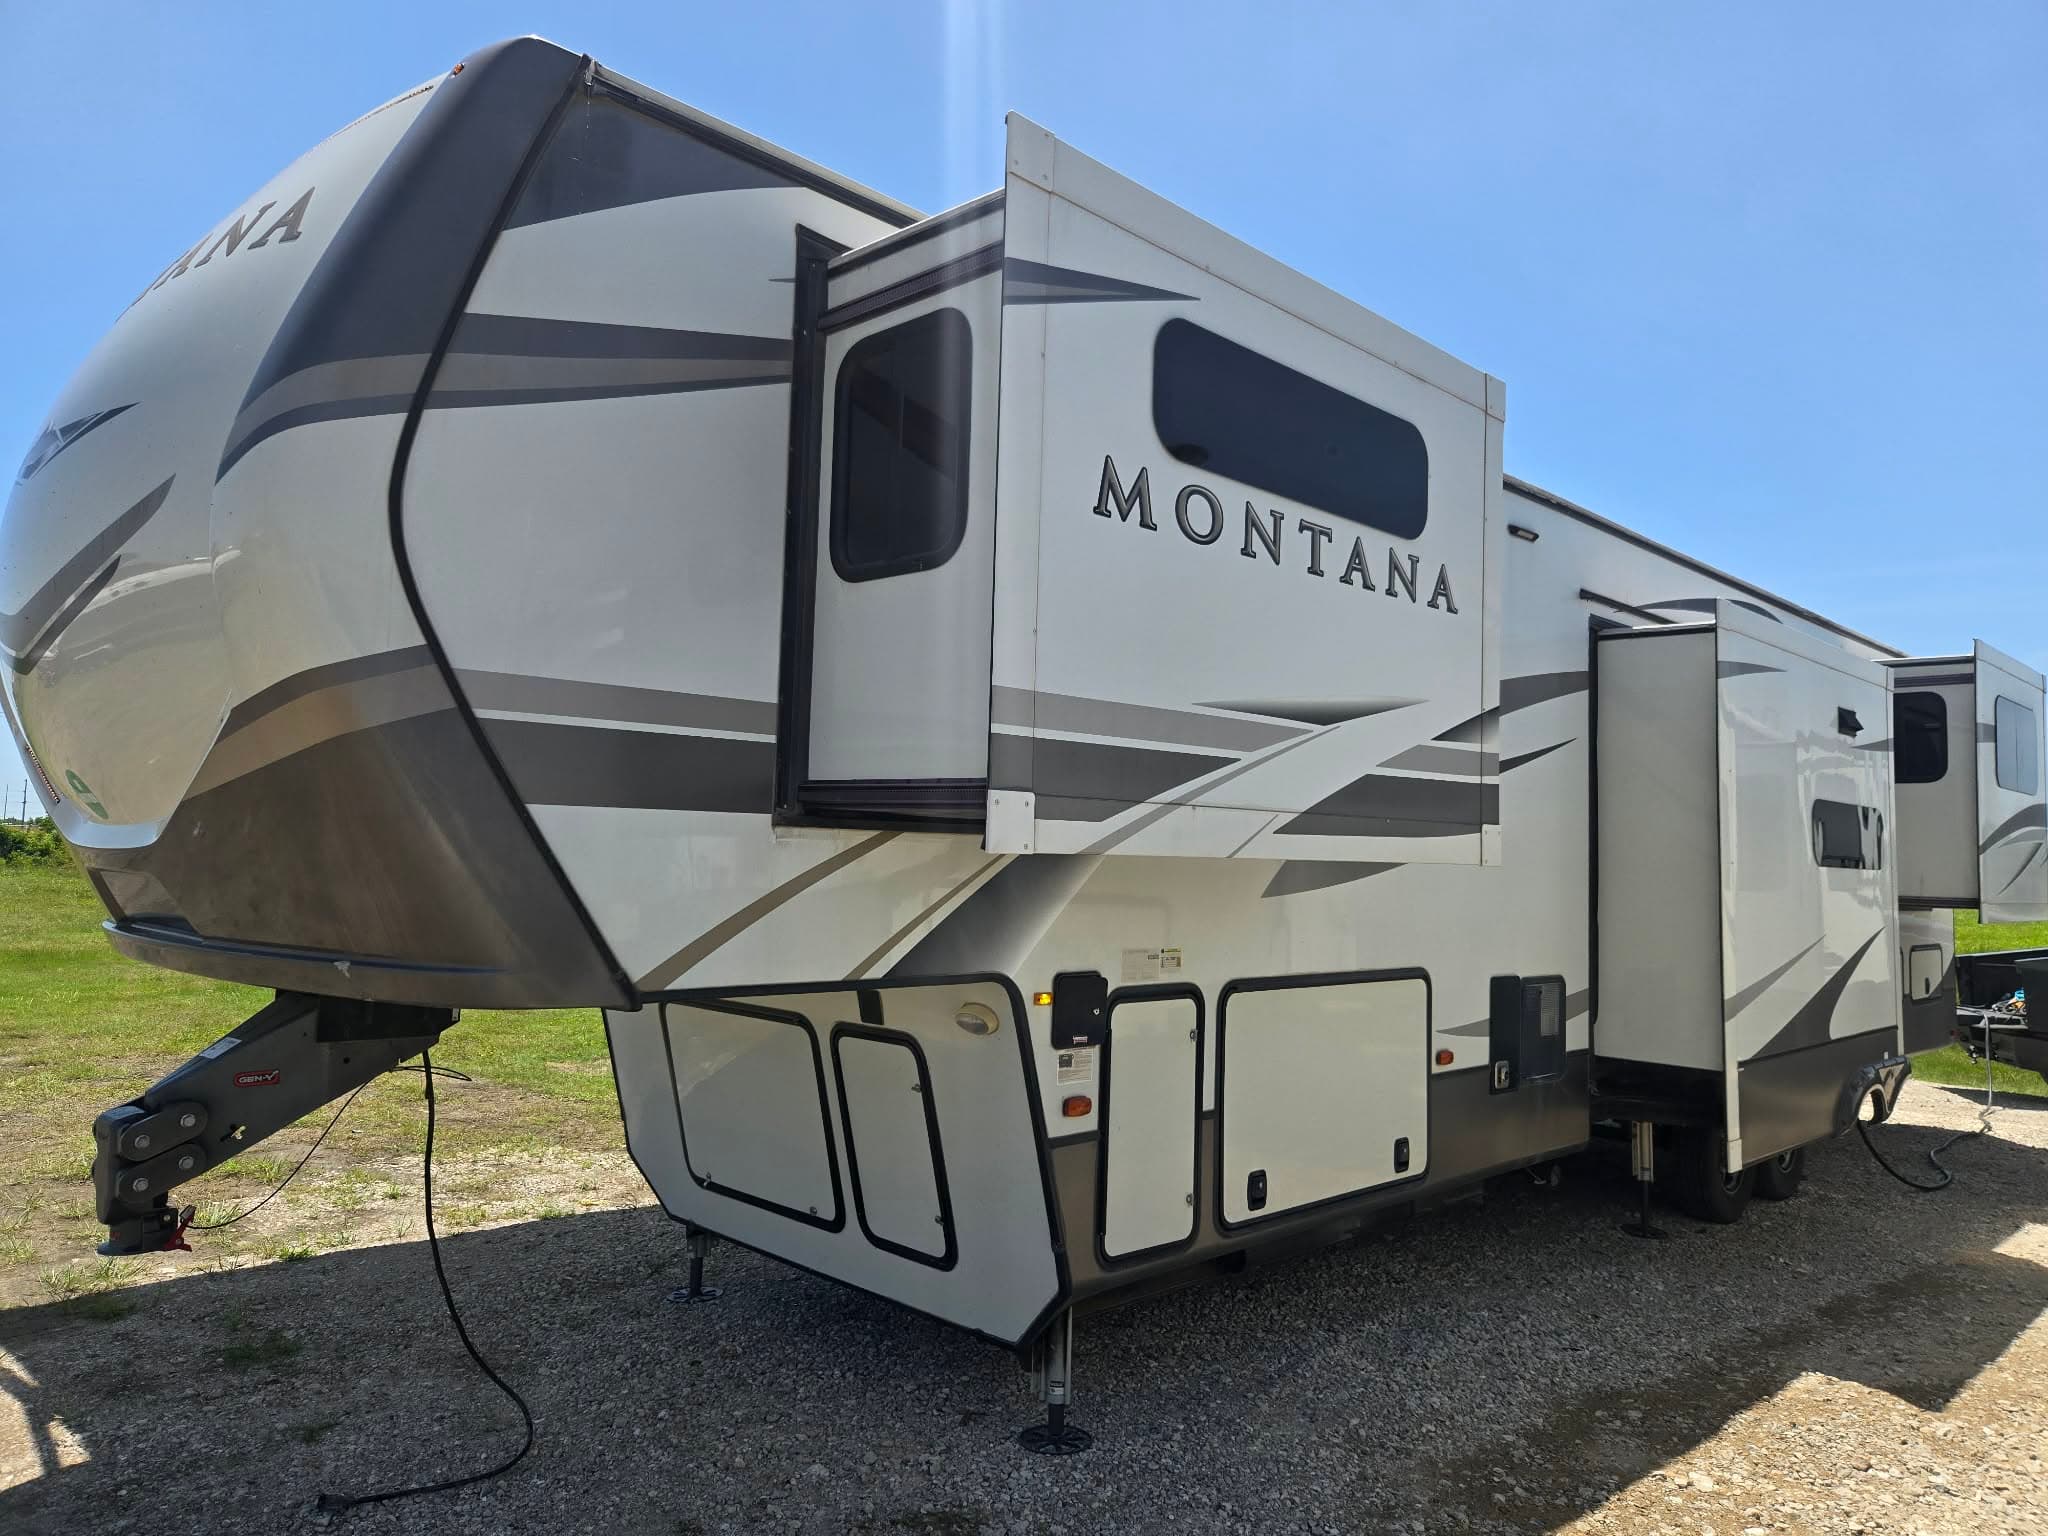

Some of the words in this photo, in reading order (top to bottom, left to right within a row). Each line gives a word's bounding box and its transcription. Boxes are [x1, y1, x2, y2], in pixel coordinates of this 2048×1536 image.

[128, 186, 316, 308] ANA
[1092, 454, 1458, 615] MONTANA
[239, 1070, 279, 1083] GEN-Y
